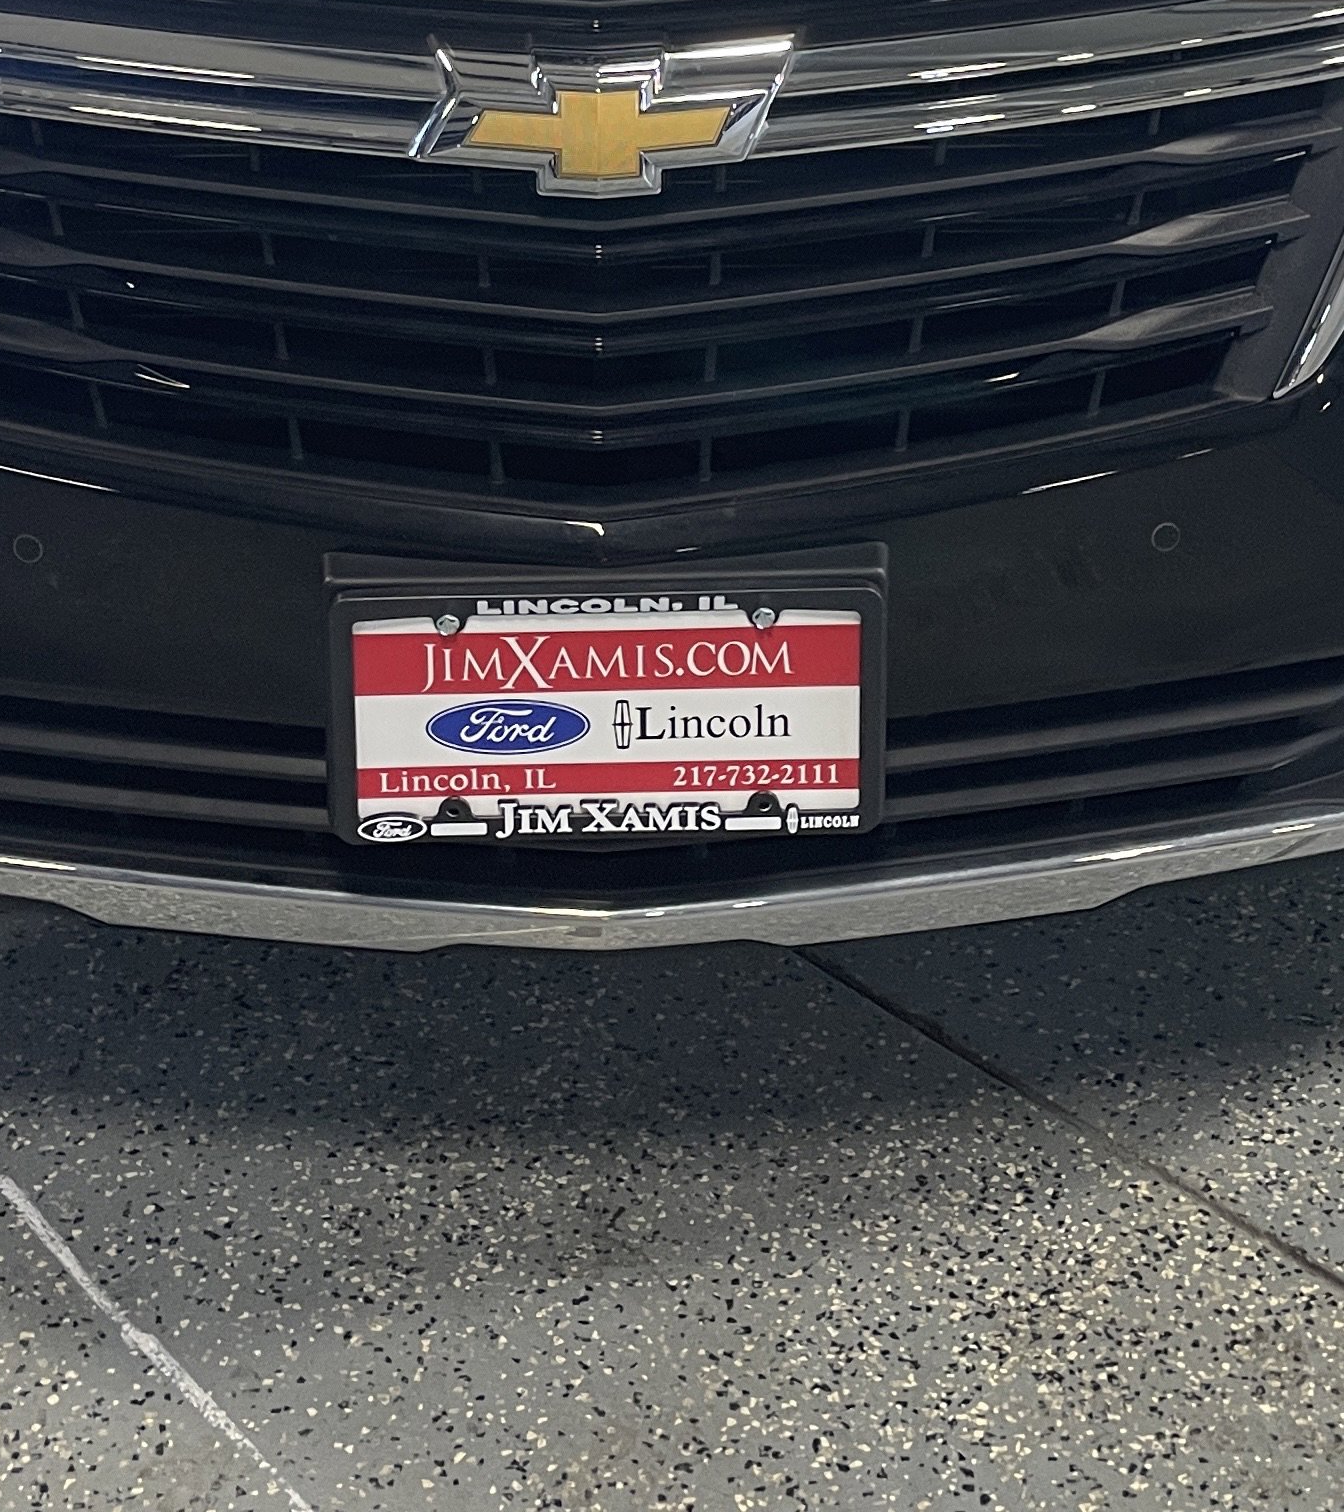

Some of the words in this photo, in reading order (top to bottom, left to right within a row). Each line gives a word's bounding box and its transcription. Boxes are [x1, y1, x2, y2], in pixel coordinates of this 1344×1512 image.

[698, 595, 738, 611] IL
[421, 635, 794, 693] JIMXAMIS.COM
[459, 707, 556, 744] Ford
[634, 703, 792, 741] Lincoln
[379, 769, 512, 794] Lincoln,
[524, 768, 557, 790] IL
[673, 763, 840, 787] 217-732-2111
[372, 821, 413, 838] Ford
[495, 803, 573, 838] JIM
[581, 803, 722, 832] XAMIS
[800, 815, 860, 829] LINCOLN
